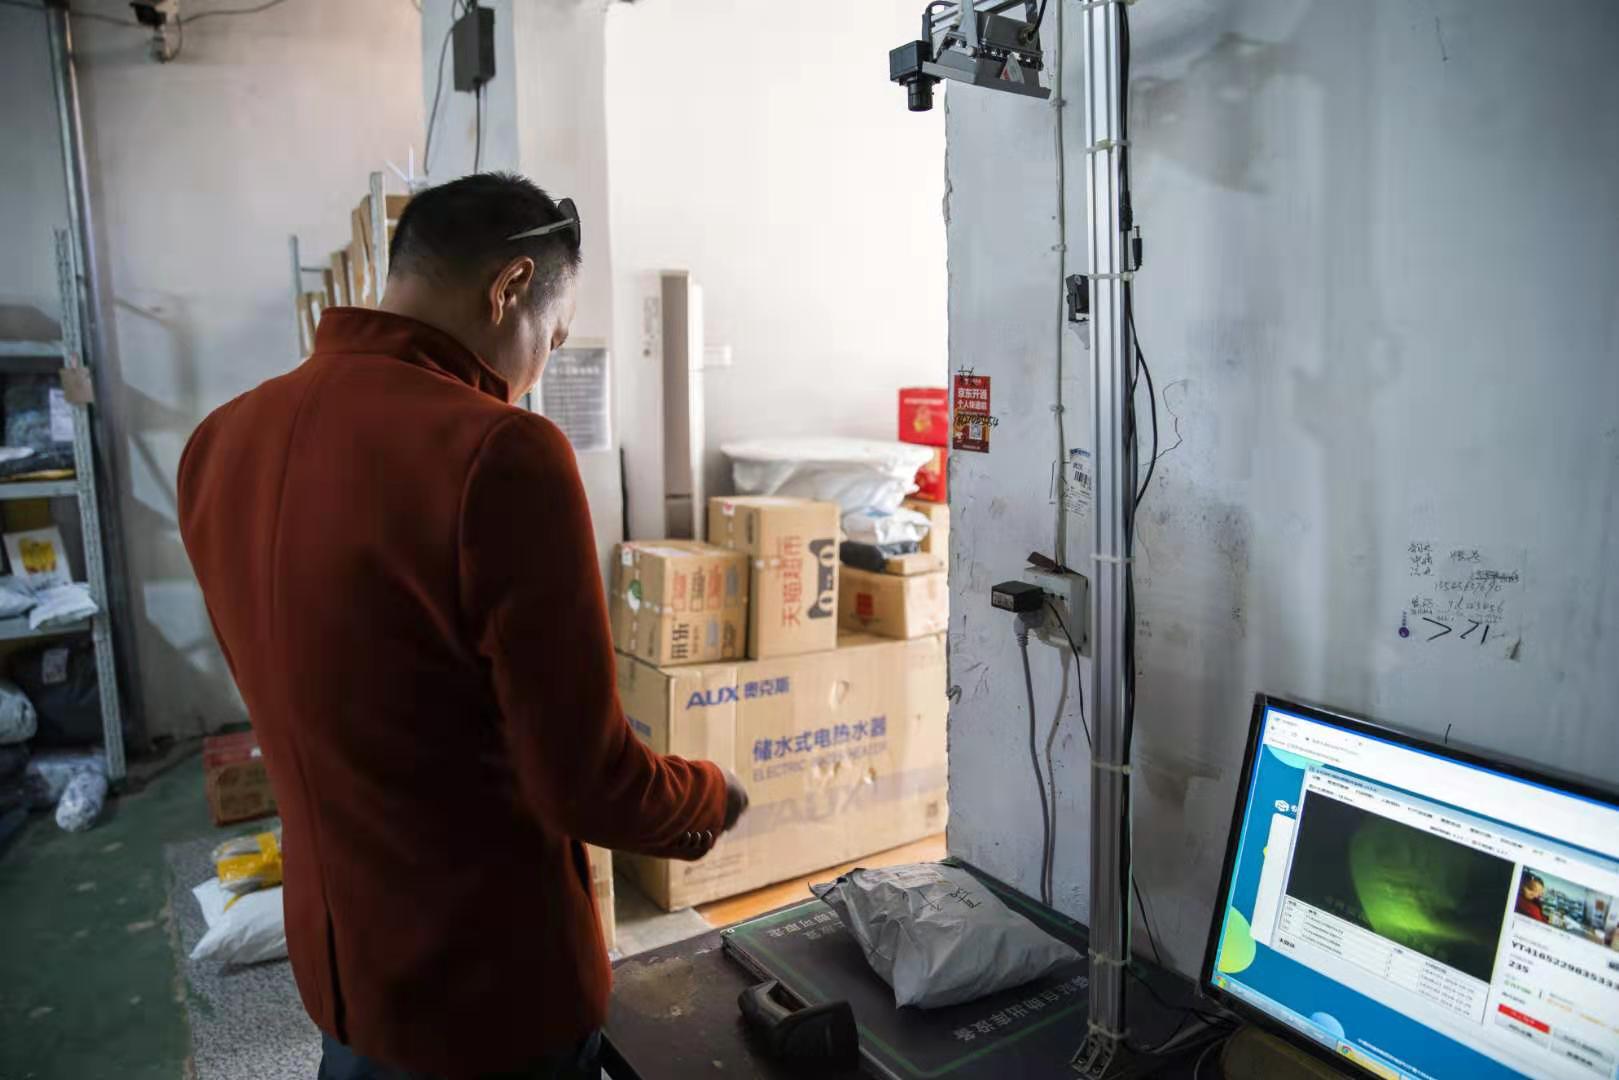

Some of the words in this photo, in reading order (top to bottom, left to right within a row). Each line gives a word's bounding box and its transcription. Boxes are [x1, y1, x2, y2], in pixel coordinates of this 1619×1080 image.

[686, 684, 740, 709] AUX
[753, 715, 887, 762] 储水式电热水器
[1508, 960, 1529, 974] 235
